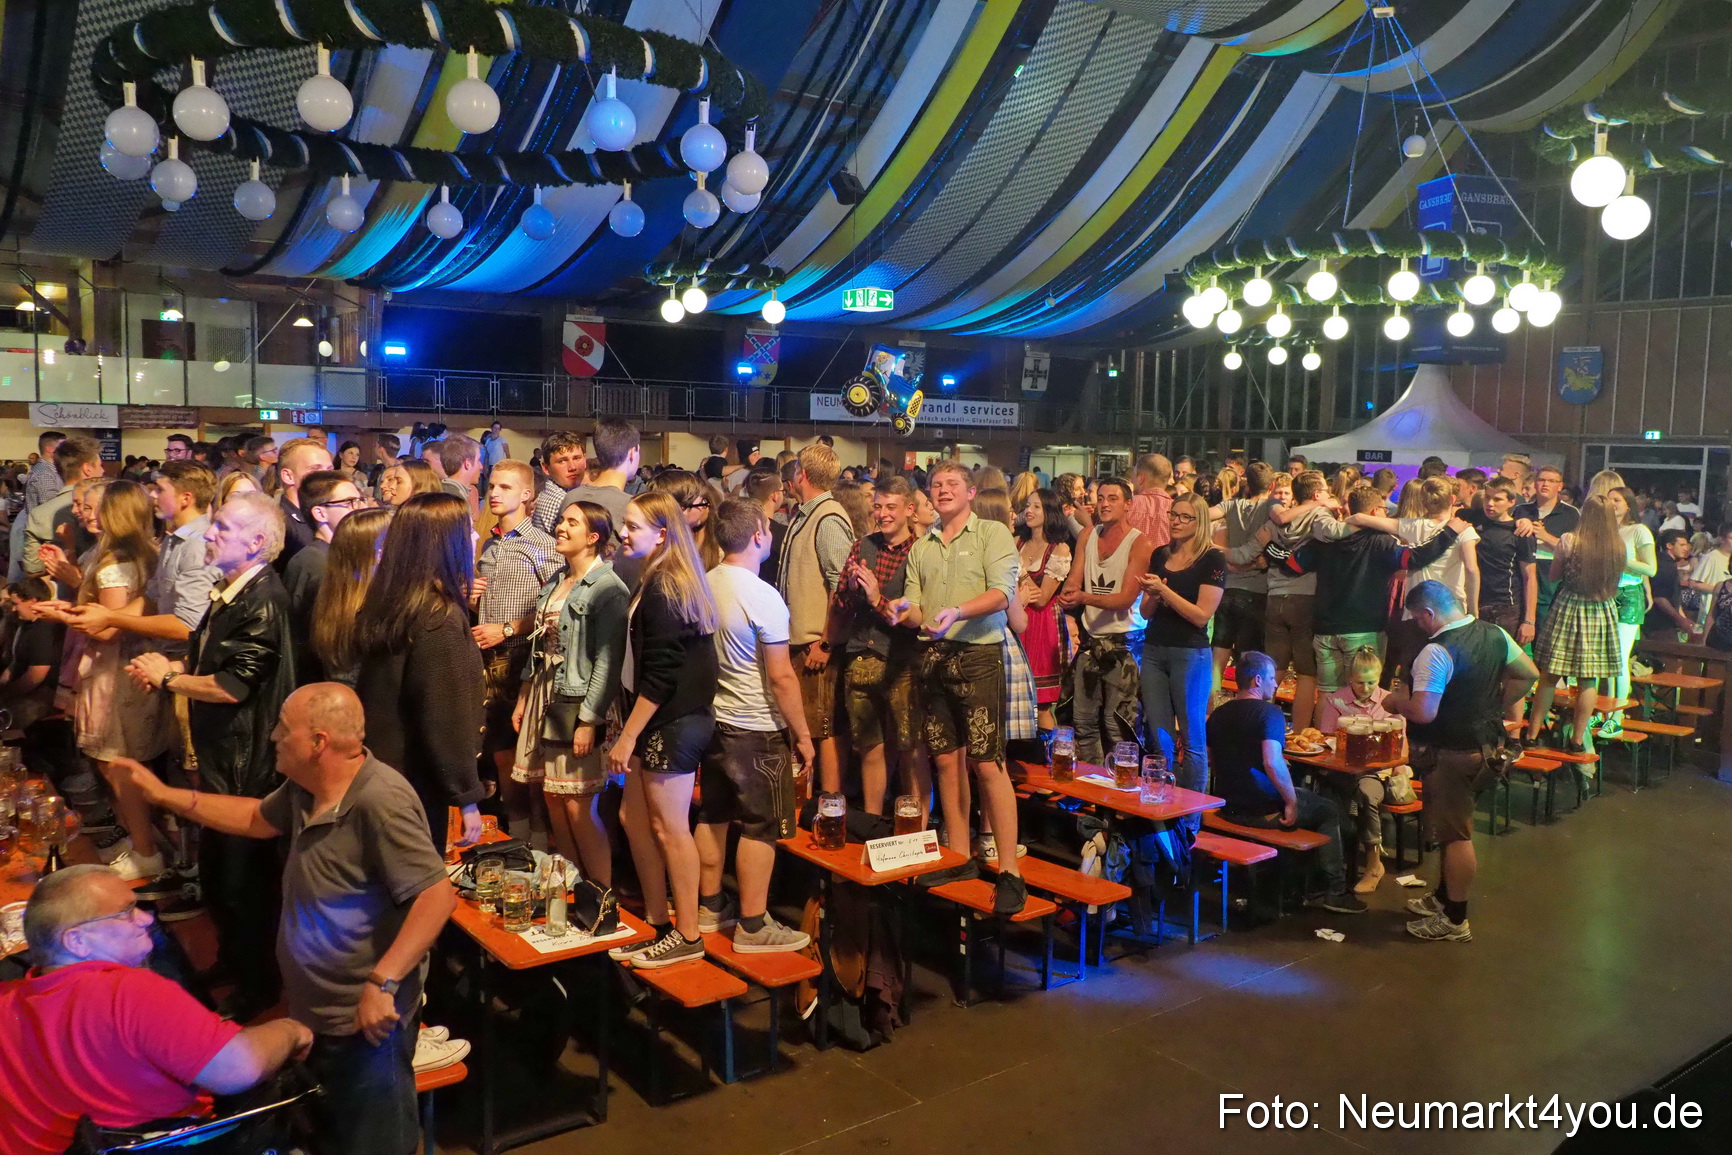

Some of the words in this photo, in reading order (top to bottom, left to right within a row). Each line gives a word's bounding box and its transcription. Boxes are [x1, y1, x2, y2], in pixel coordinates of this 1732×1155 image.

[816, 396, 844, 407] NEUM
[38, 403, 109, 425] Schönblick
[921, 402, 956, 414] randl
[963, 404, 1014, 416] services
[1365, 452, 1383, 461] BAR
[870, 840, 898, 849] RESERVIERT
